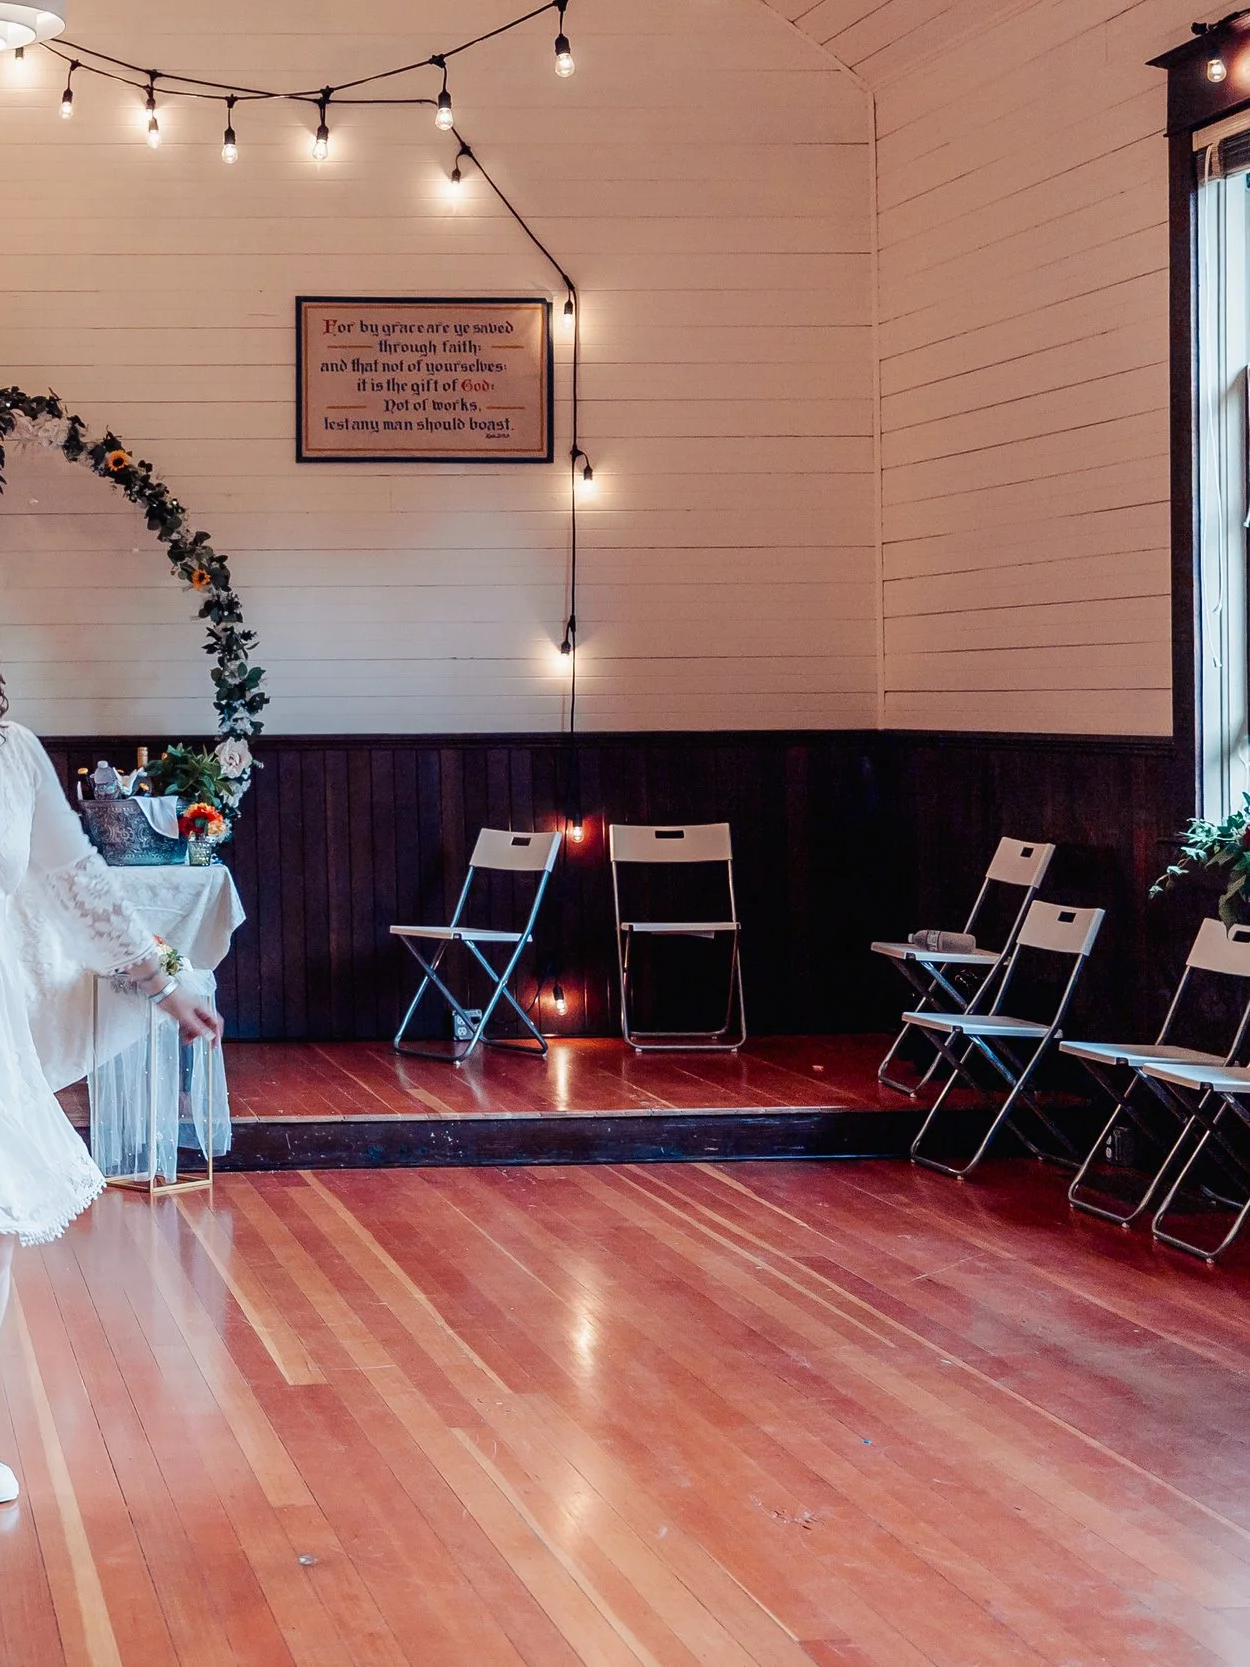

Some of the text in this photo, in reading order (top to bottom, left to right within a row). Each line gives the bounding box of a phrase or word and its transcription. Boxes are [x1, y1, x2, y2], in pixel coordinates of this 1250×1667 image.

[323, 319, 513, 336] For by grace are ye saved
[378, 340, 437, 357] through
[321, 360, 347, 372] and
[351, 359, 378, 374] that
[382, 360, 404, 372] not
[407, 359, 423, 372] of
[357, 379, 368, 392] it
[371, 380, 383, 392] is
[387, 378, 407, 393] the
[411, 379, 438, 395] gift
[443, 378, 458, 392] of
[383, 399, 410, 412] Not
[414, 399, 429, 411] of
[325, 417, 350, 430] lest
[352, 421, 379, 433] any
[383, 421, 413, 430] man
[417, 418, 465, 433] should
